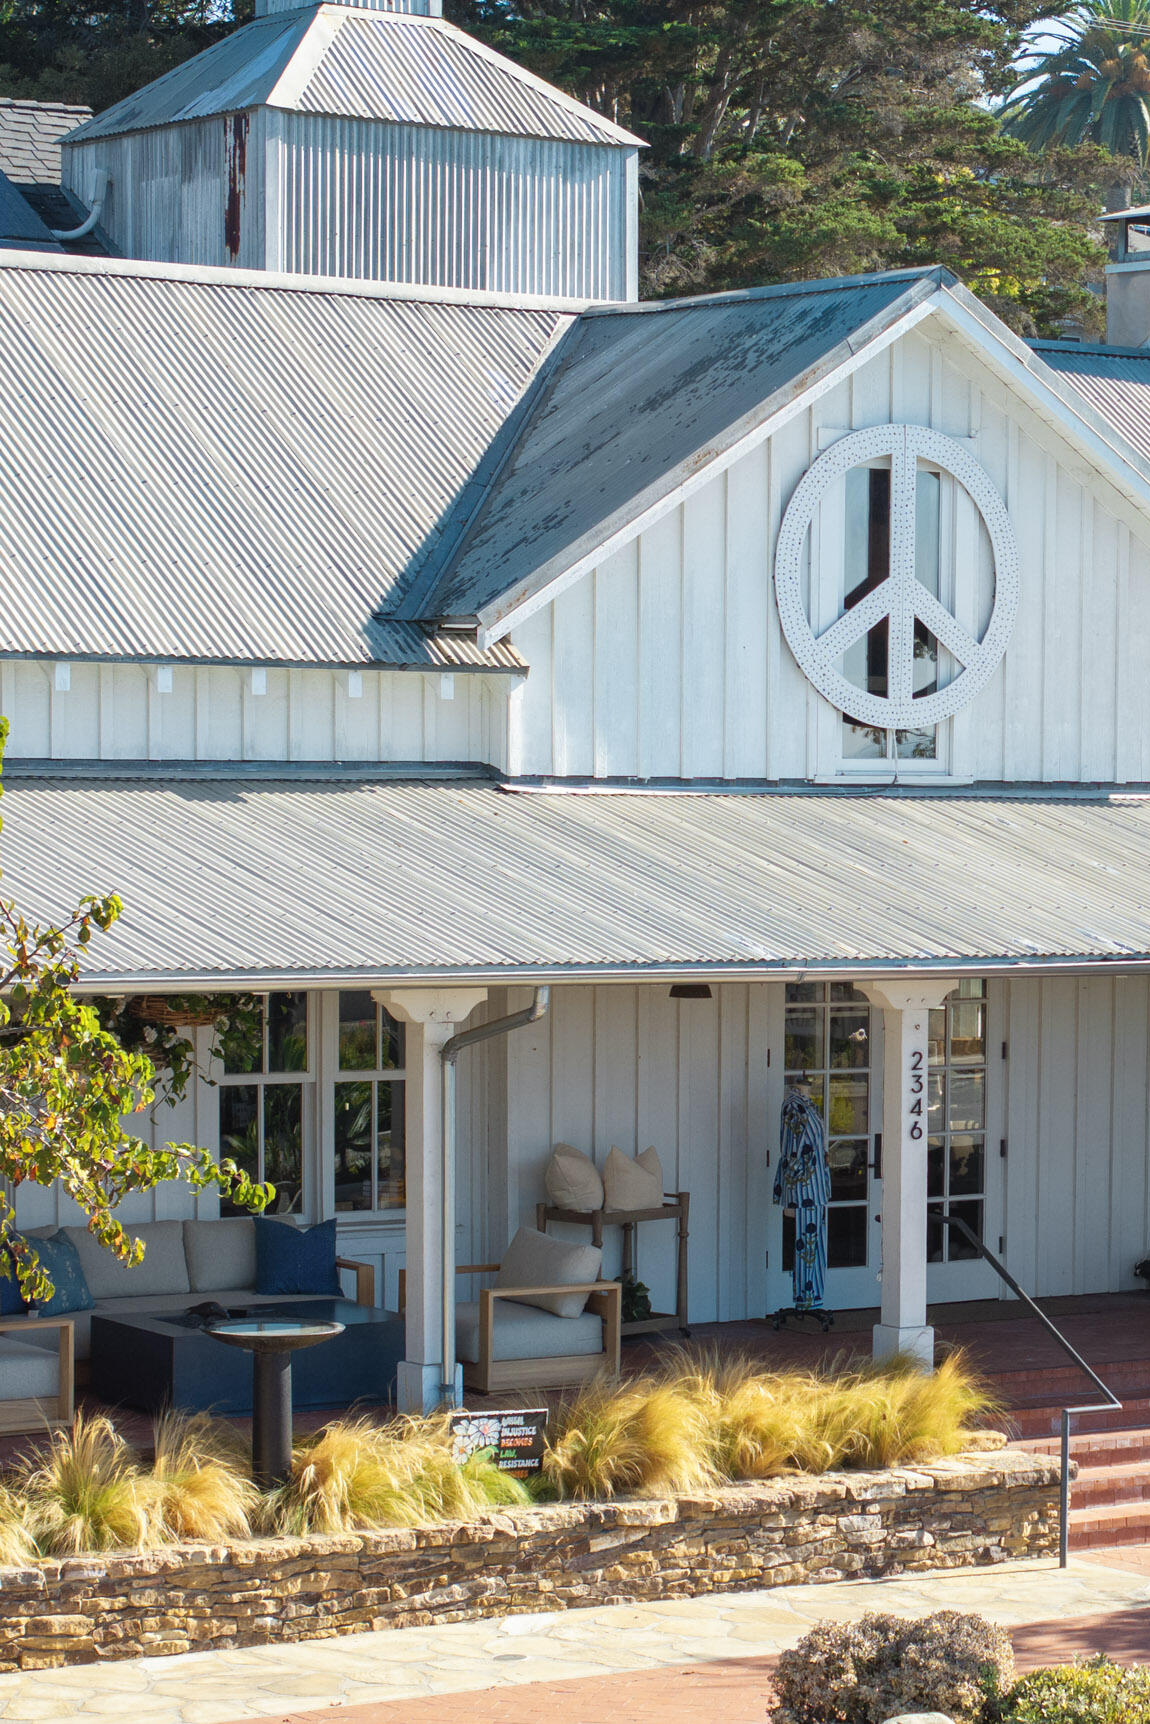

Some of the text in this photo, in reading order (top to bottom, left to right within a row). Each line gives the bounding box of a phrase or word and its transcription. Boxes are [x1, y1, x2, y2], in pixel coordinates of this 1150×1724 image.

[910, 1051, 923, 1140] 2346
[501, 1426, 537, 1437] INJUSTICE
[500, 1437, 533, 1448] BECOMES
[499, 1459, 539, 1469] RESISTANCE
